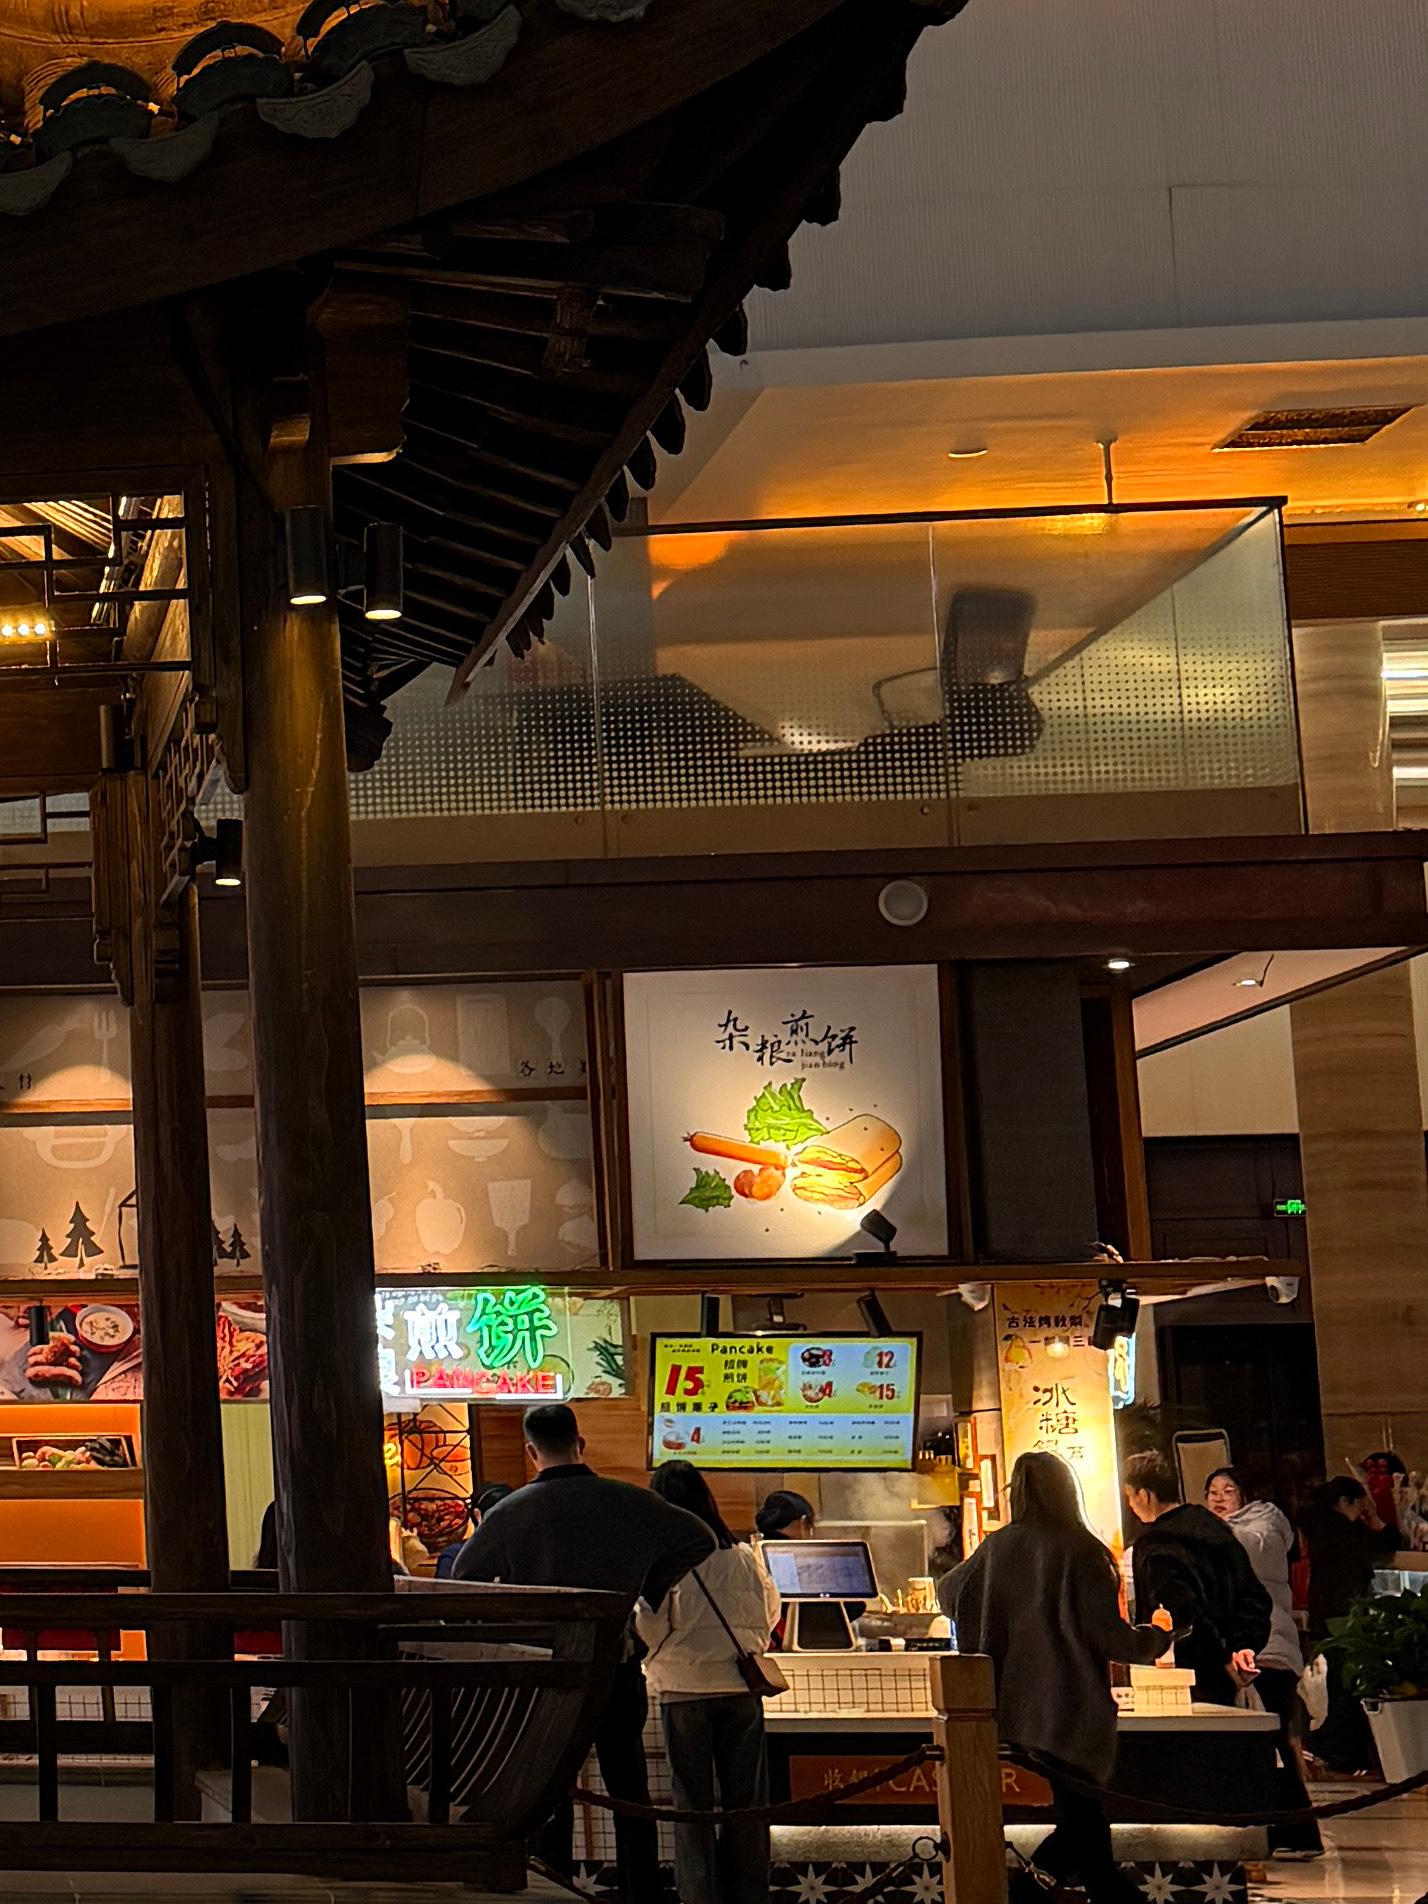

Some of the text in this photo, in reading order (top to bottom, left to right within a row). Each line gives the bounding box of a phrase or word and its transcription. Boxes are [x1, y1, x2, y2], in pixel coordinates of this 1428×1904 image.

[715, 1009, 858, 1066] 杂粮煎饼
[710, 1341, 774, 1356] Pancake
[410, 1366, 556, 1394] PANCAKE
[664, 1363, 705, 1397] 15
